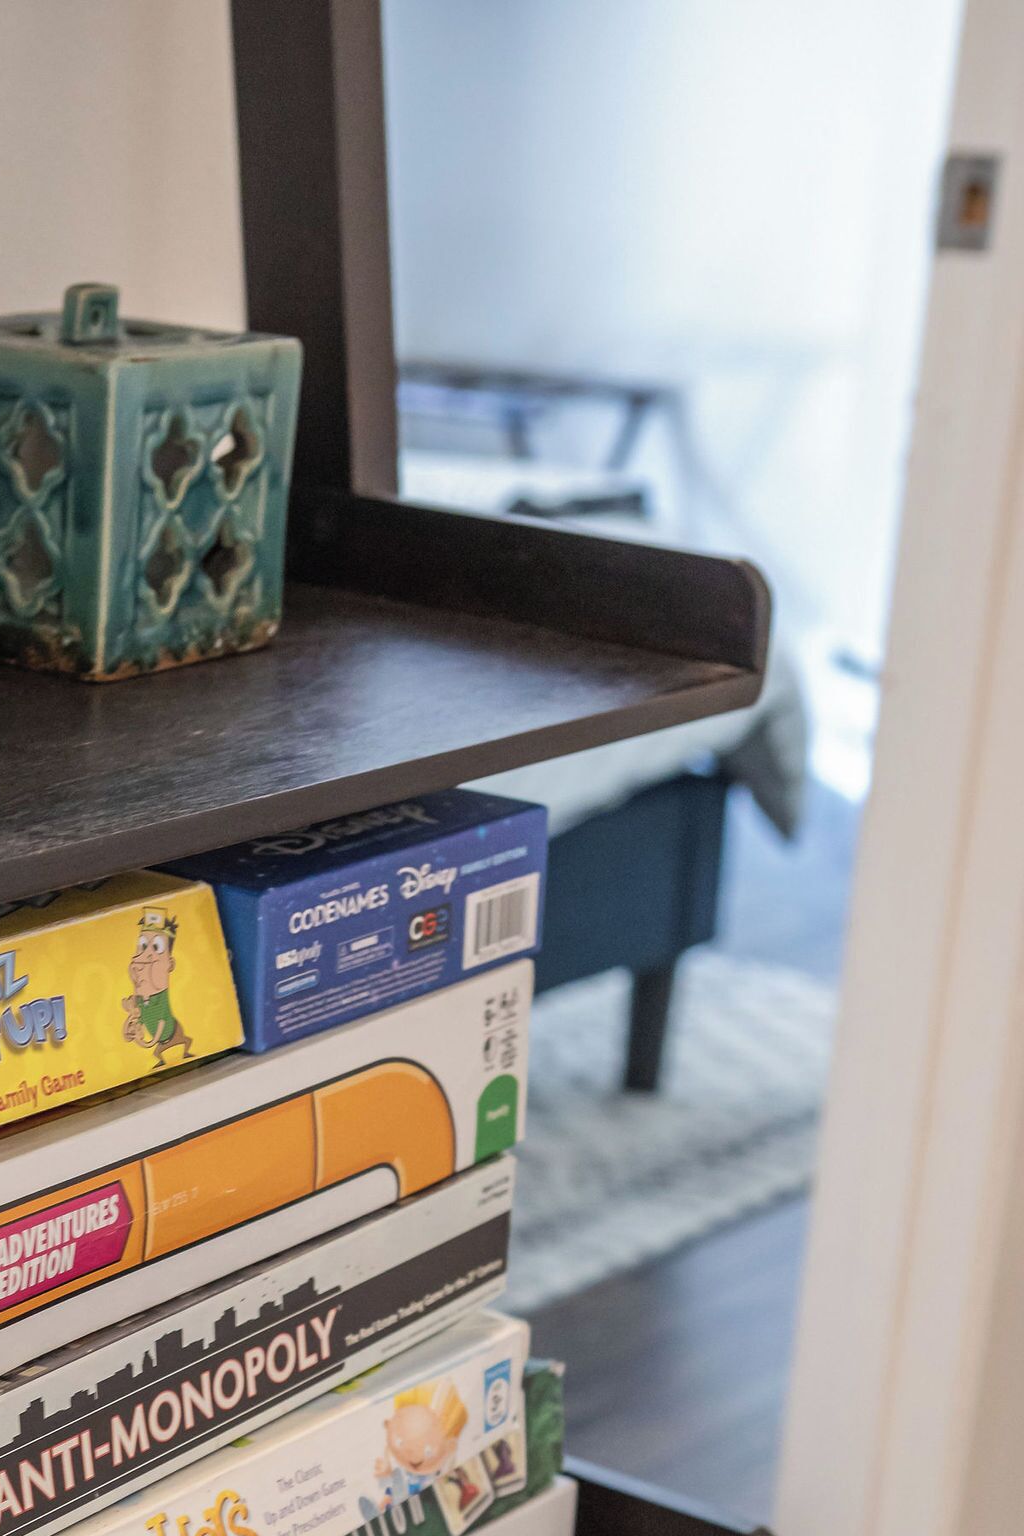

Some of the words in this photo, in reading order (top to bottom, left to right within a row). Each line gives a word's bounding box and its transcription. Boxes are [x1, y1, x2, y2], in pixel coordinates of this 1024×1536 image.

[289, 884, 390, 935] CODENAMES
[396, 863, 459, 900] Disney
[1, 994, 68, 1048] UP!
[39, 1069, 87, 1097] Game
